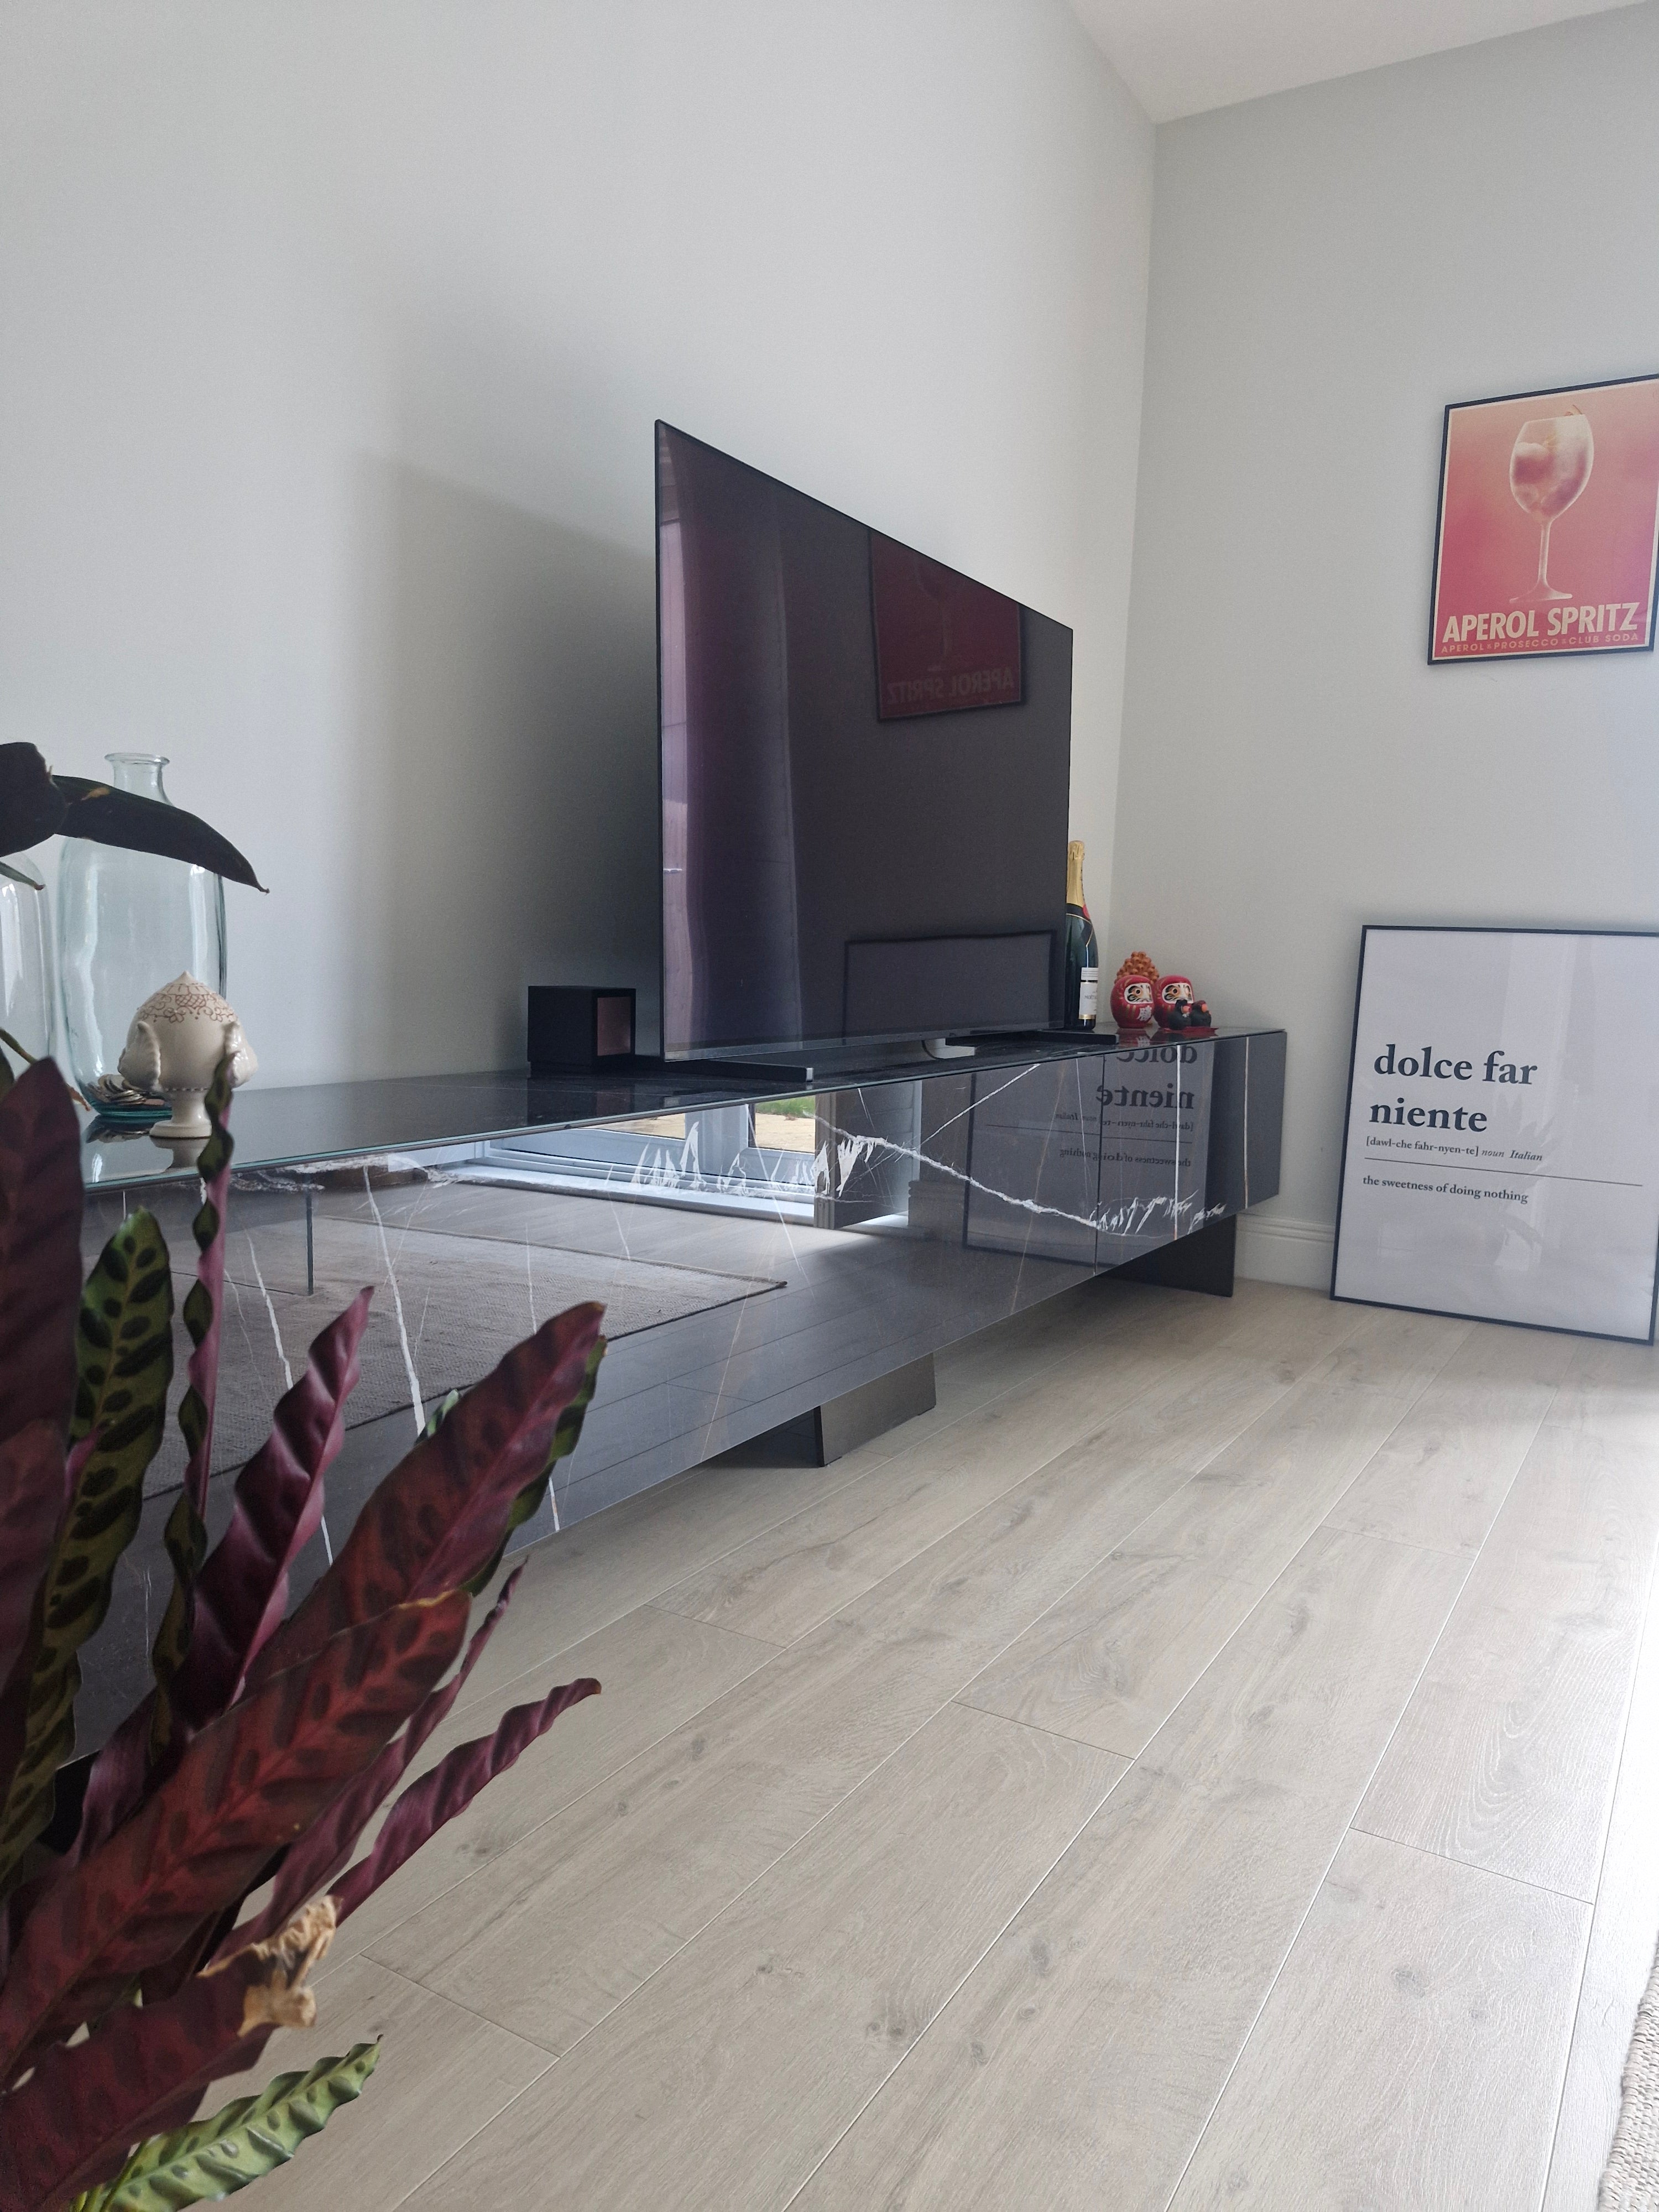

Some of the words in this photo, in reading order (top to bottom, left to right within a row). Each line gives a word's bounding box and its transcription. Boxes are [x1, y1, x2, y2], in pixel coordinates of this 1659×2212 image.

[1442, 610, 1539, 643] APEROL
[1547, 602, 1640, 637] SPRITZ
[1441, 643, 1484, 653] APEROL
[1494, 638, 1558, 650] PROSECCO
[1569, 635, 1599, 645] CLUB
[1605, 633, 1639, 643] SODA
[1374, 1044, 1473, 1080] dolce
[1482, 1050, 1537, 1085] far
[1369, 1098, 1487, 1132] niente
[1366, 1135, 1412, 1150] [dawl-che
[1414, 1140, 1479, 1157] fahr-nyen-te]
[1482, 1150, 1505, 1159] noun
[1509, 1149, 1543, 1161] Italian
[1363, 1175, 1380, 1186] the
[1382, 1178, 1433, 1192] sweetness
[1436, 1183, 1449, 1193] of
[1449, 1184, 1481, 1199] doing
[1484, 1188, 1529, 1204] nothing
